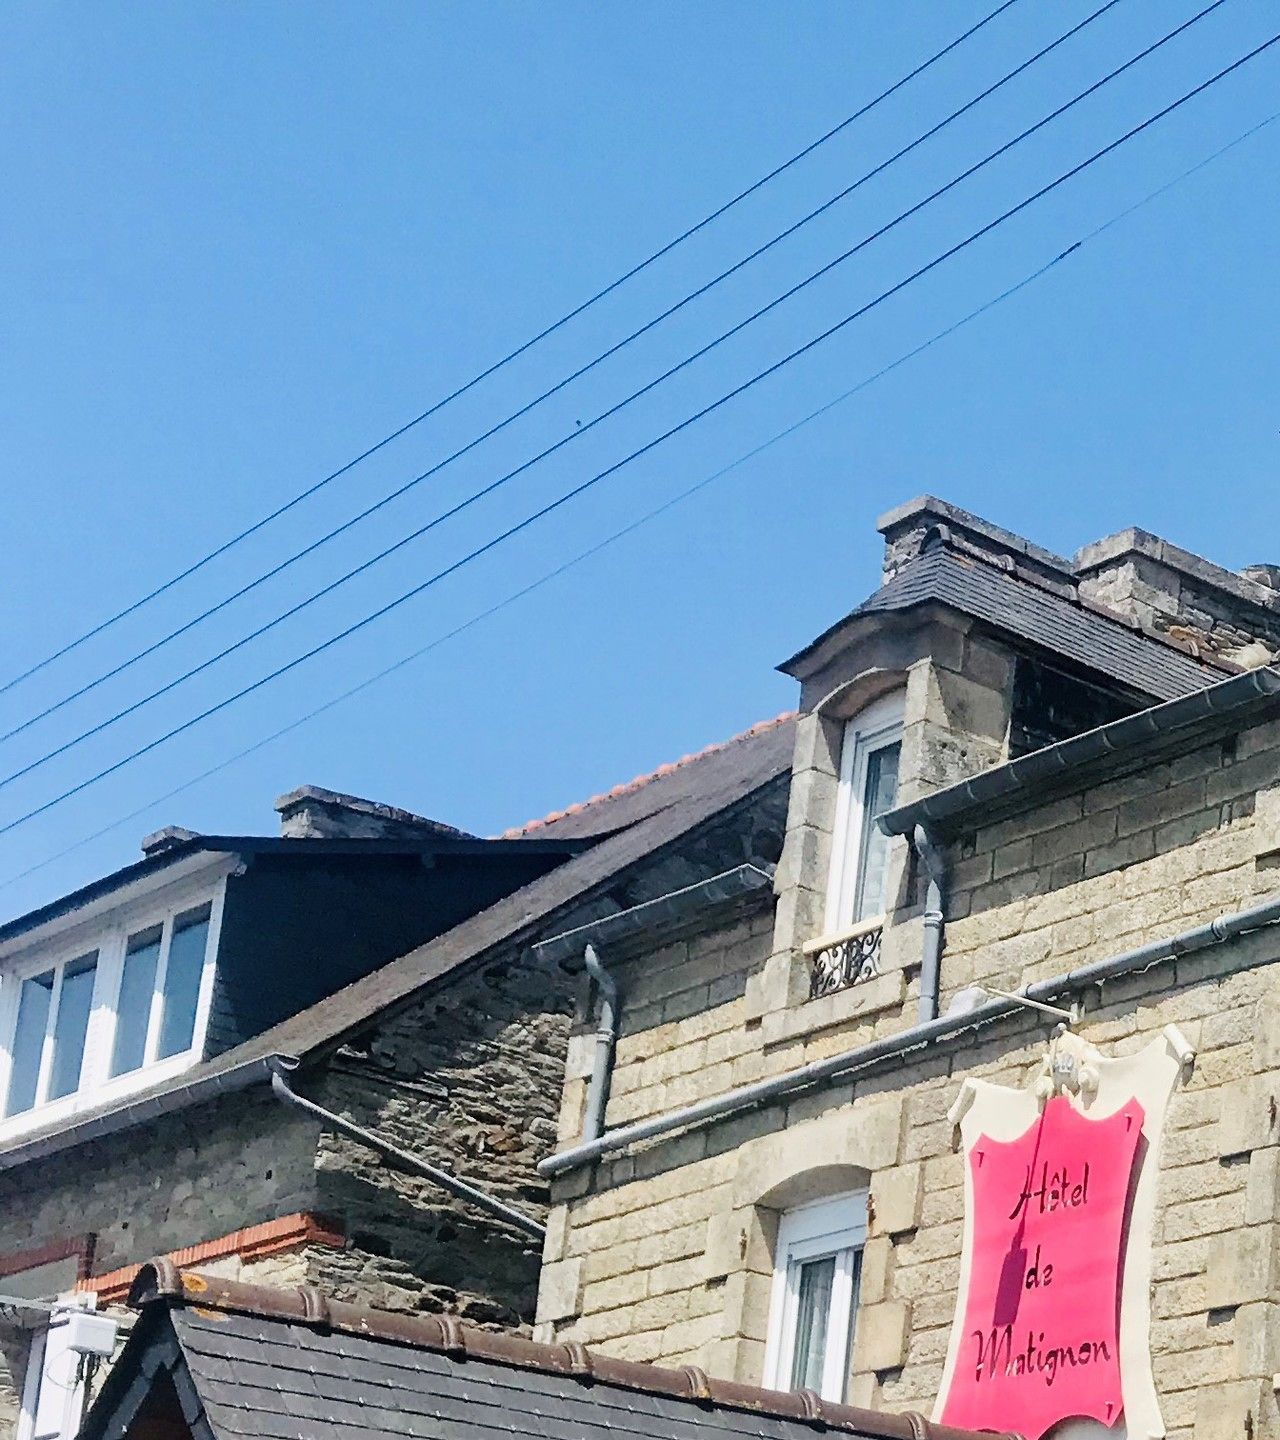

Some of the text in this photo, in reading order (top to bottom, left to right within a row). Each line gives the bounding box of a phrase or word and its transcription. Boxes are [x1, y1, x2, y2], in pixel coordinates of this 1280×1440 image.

[1009, 1161, 1089, 1220] Hôtel
[1025, 1244, 1053, 1289] de
[971, 1324, 1110, 1386] Matignon
